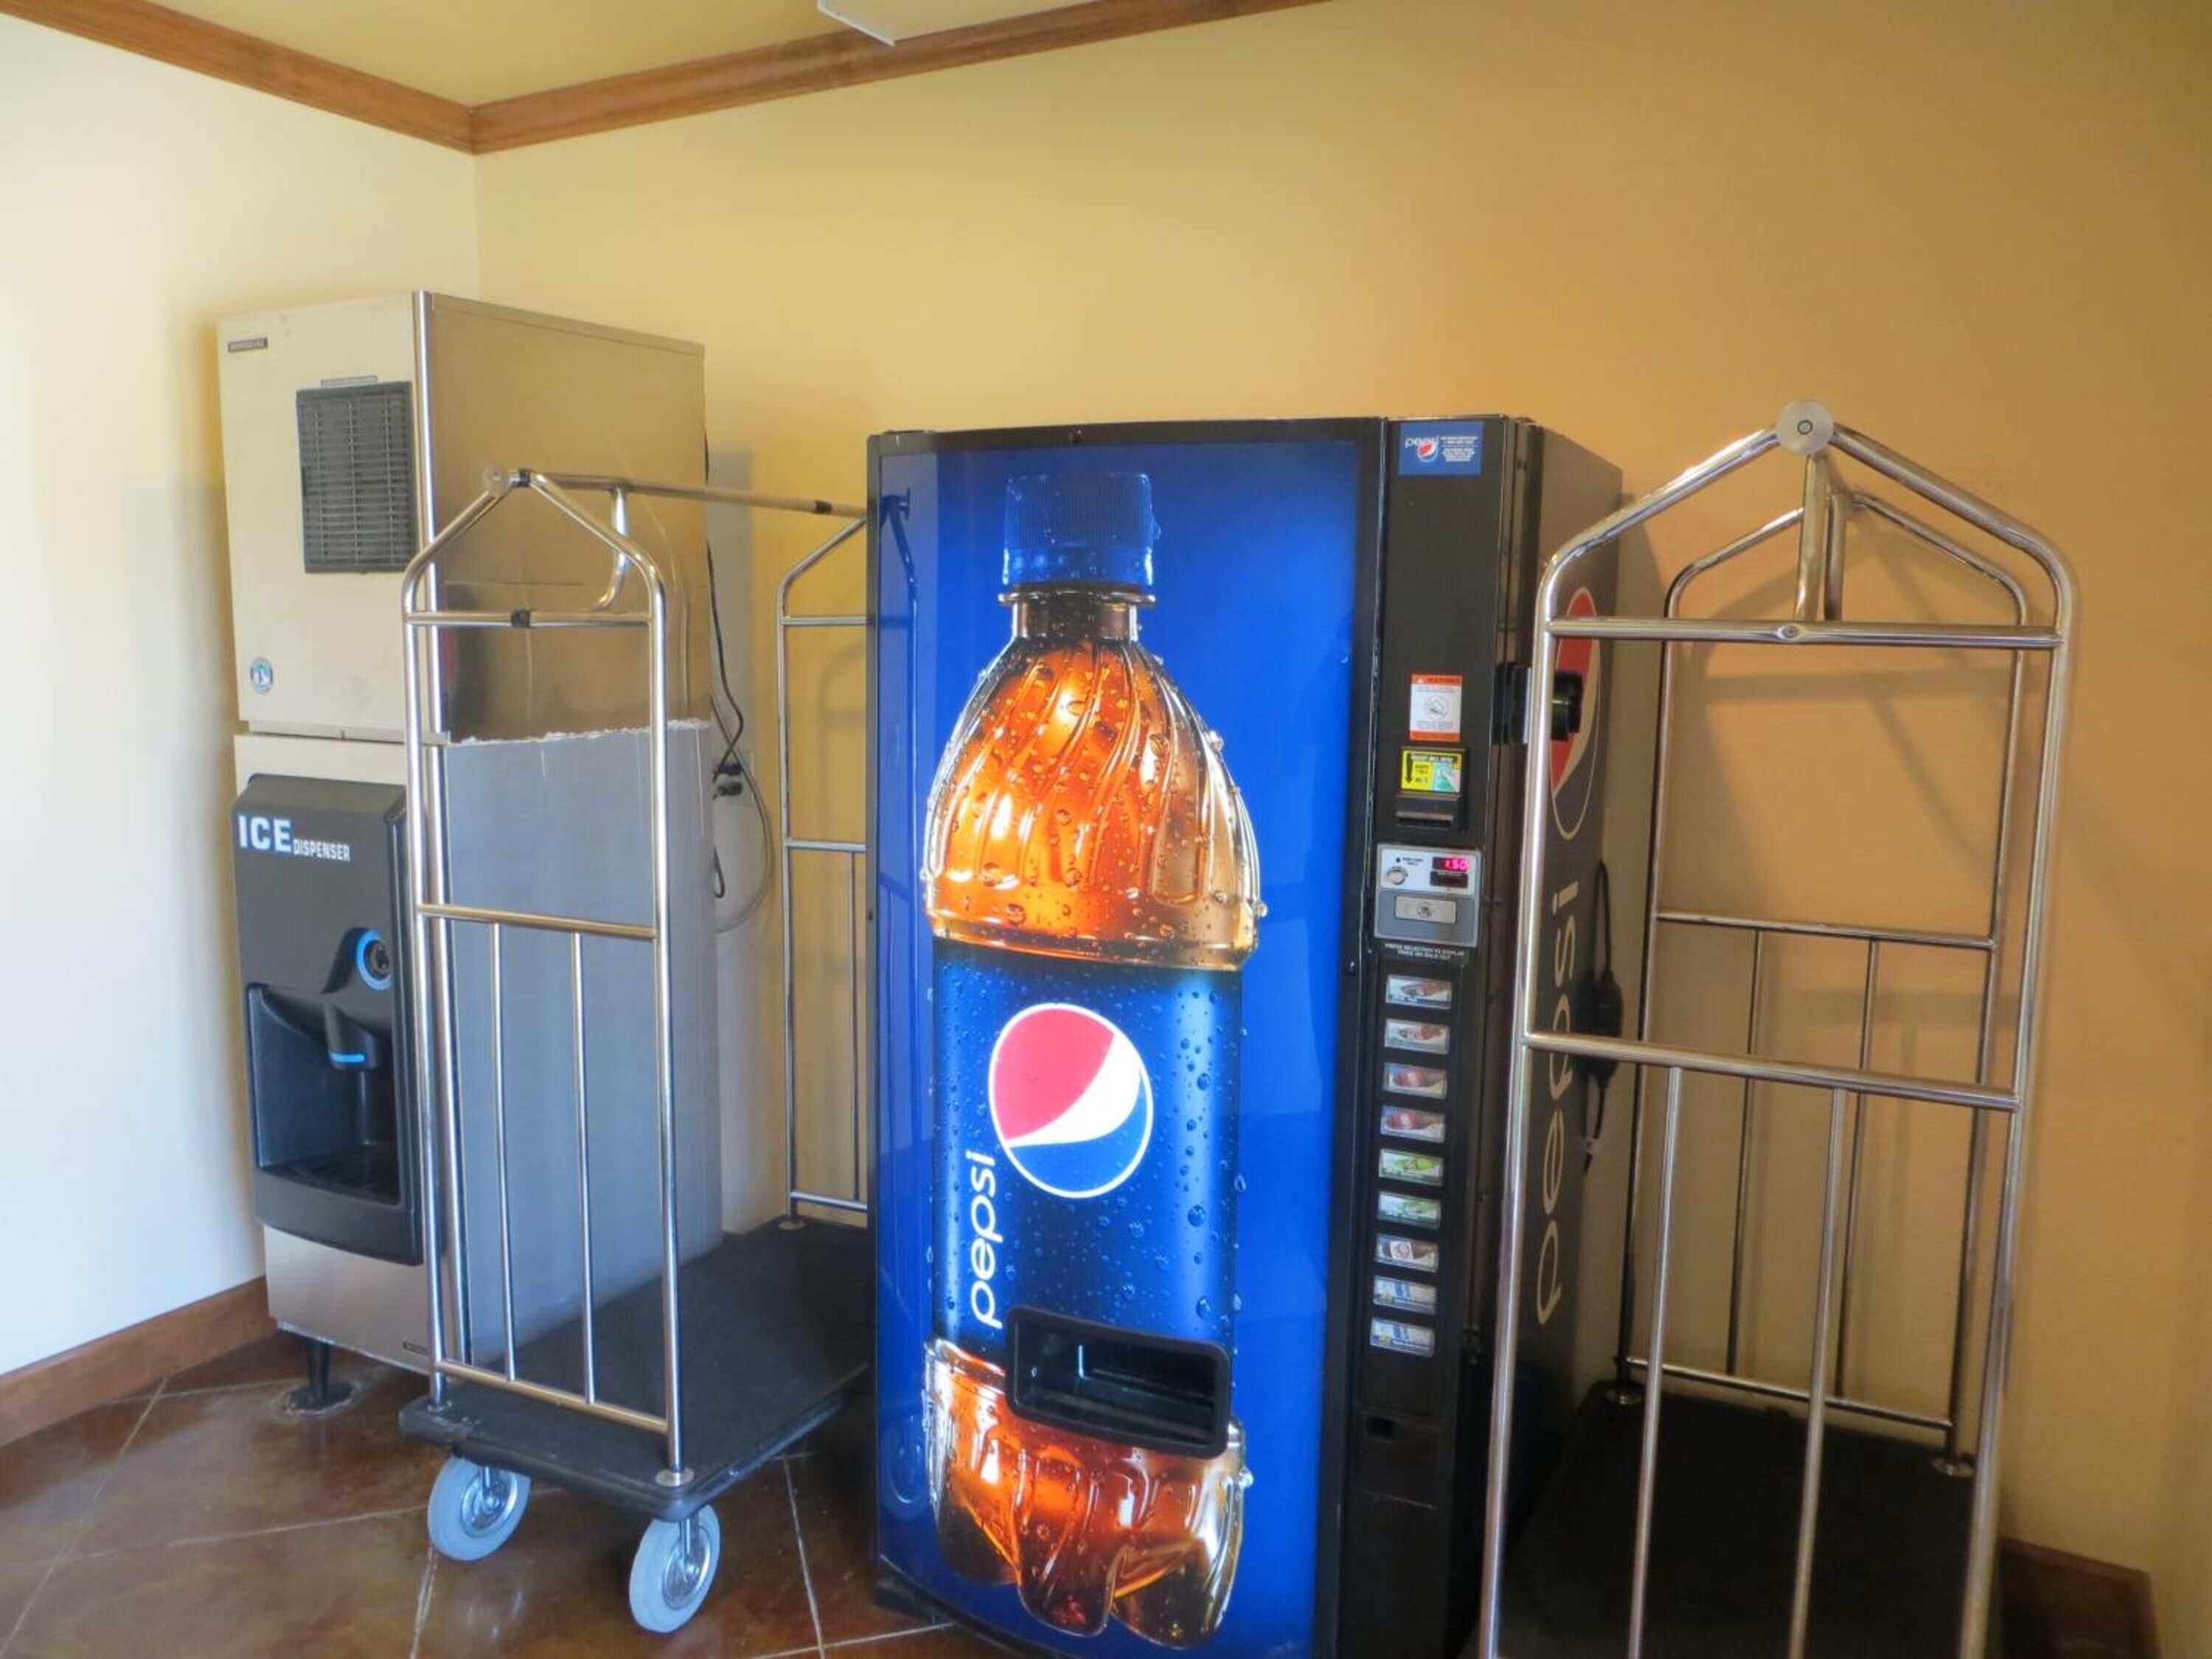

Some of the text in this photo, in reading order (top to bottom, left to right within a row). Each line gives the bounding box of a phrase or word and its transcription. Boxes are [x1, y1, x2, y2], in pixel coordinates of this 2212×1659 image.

[238, 814, 351, 862] ICE DISPENSER
[1537, 880, 1579, 1325] pepsi
[965, 1150, 1004, 1330] pepsi
